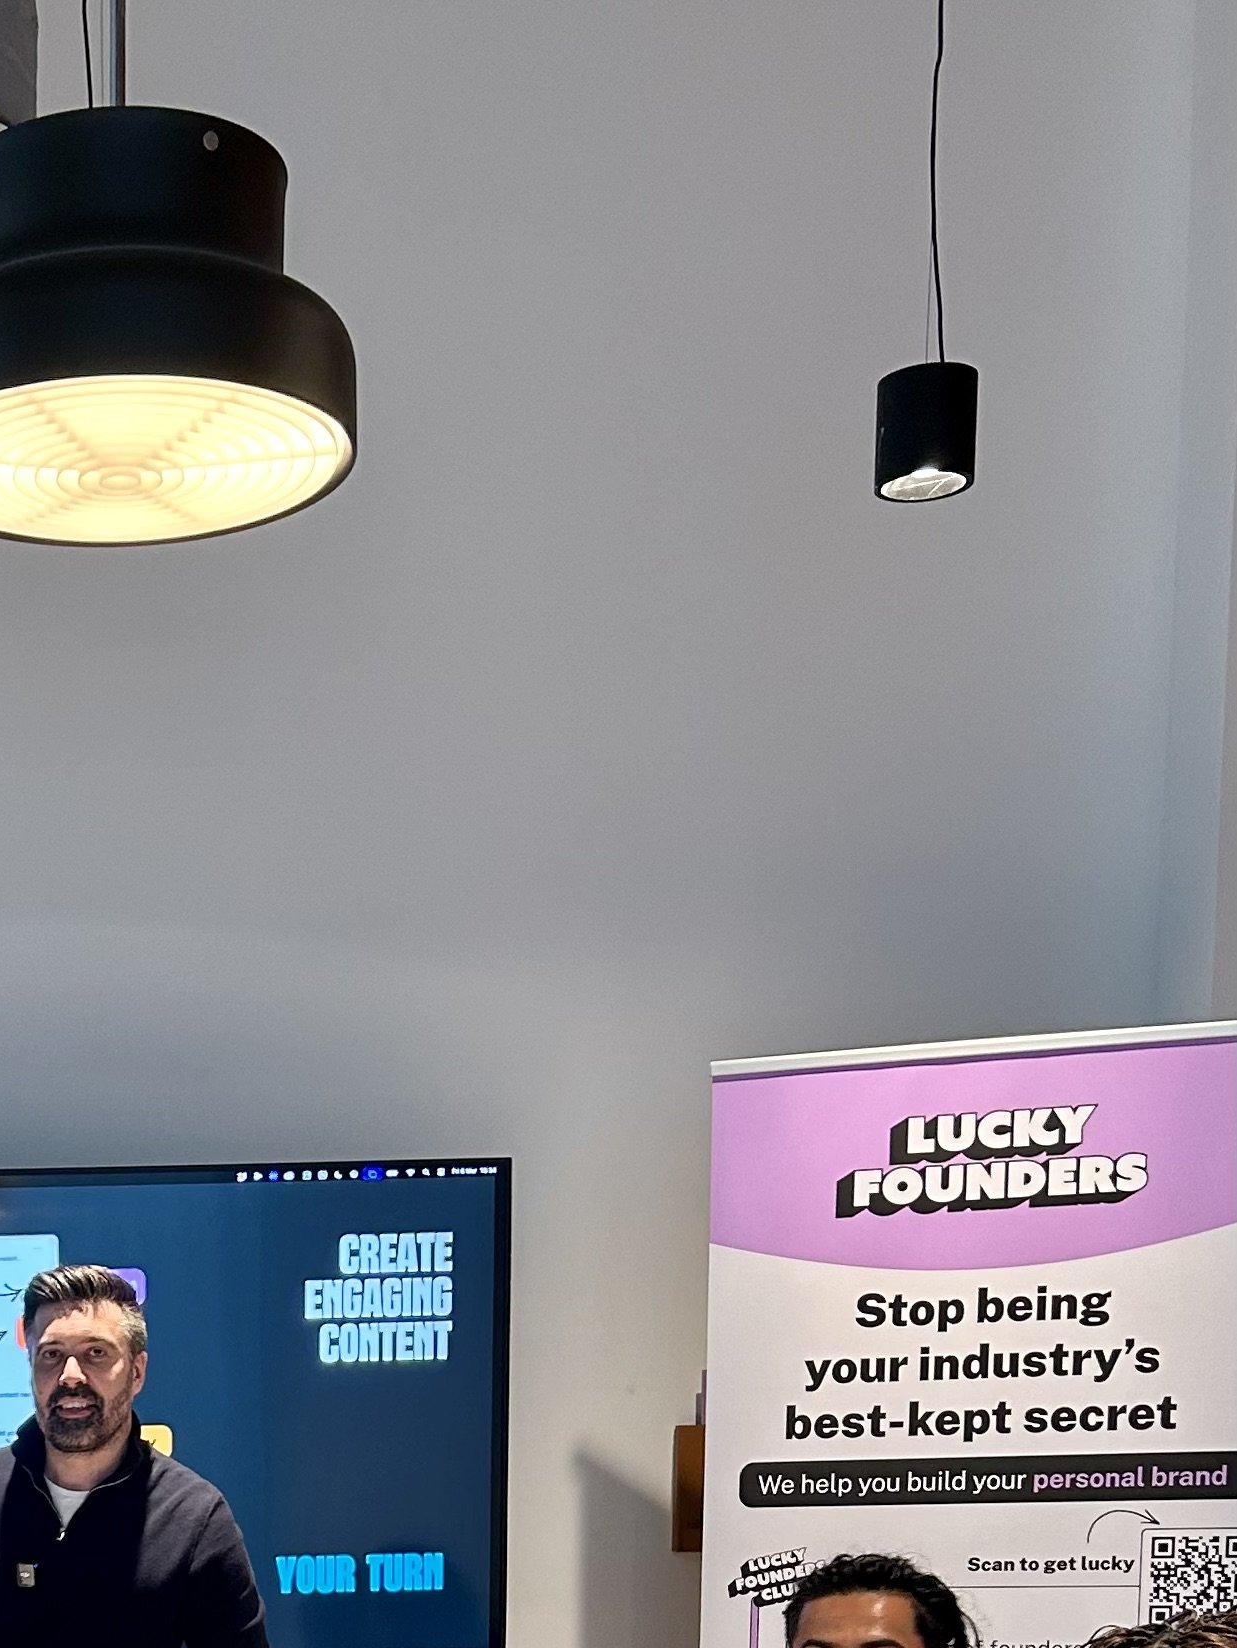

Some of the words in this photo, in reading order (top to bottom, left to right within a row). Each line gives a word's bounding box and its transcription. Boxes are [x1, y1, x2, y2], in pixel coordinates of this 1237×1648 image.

[889, 1103, 1099, 1165] LUCKY
[835, 1152, 1148, 1218] FOUNDERS
[338, 1231, 454, 1275] CREATE
[304, 1275, 454, 1320] ENGAGING
[855, 1291, 965, 1333] Stop
[977, 1286, 1112, 1327] being
[319, 1319, 454, 1363] CONTENT
[805, 1355, 909, 1392] your
[785, 1400, 1012, 1442] best-kept
[1023, 1396, 1178, 1434] secret
[758, 1474, 795, 1495] We
[801, 1472, 852, 1497] help
[858, 1474, 901, 1497] you
[906, 1470, 967, 1492] build
[972, 1474, 1026, 1495] your
[1032, 1465, 1145, 1493] personal
[1151, 1464, 1228, 1488] brand
[275, 1554, 357, 1595] YOUR
[365, 1551, 445, 1593] TURN
[741, 1546, 807, 1575] LUCKY
[967, 1556, 1015, 1573] Scan
[1020, 1557, 1040, 1572] to
[1044, 1558, 1078, 1577] get
[1082, 1555, 1135, 1576] lucky
[755, 1581, 800, 1607] CLU
